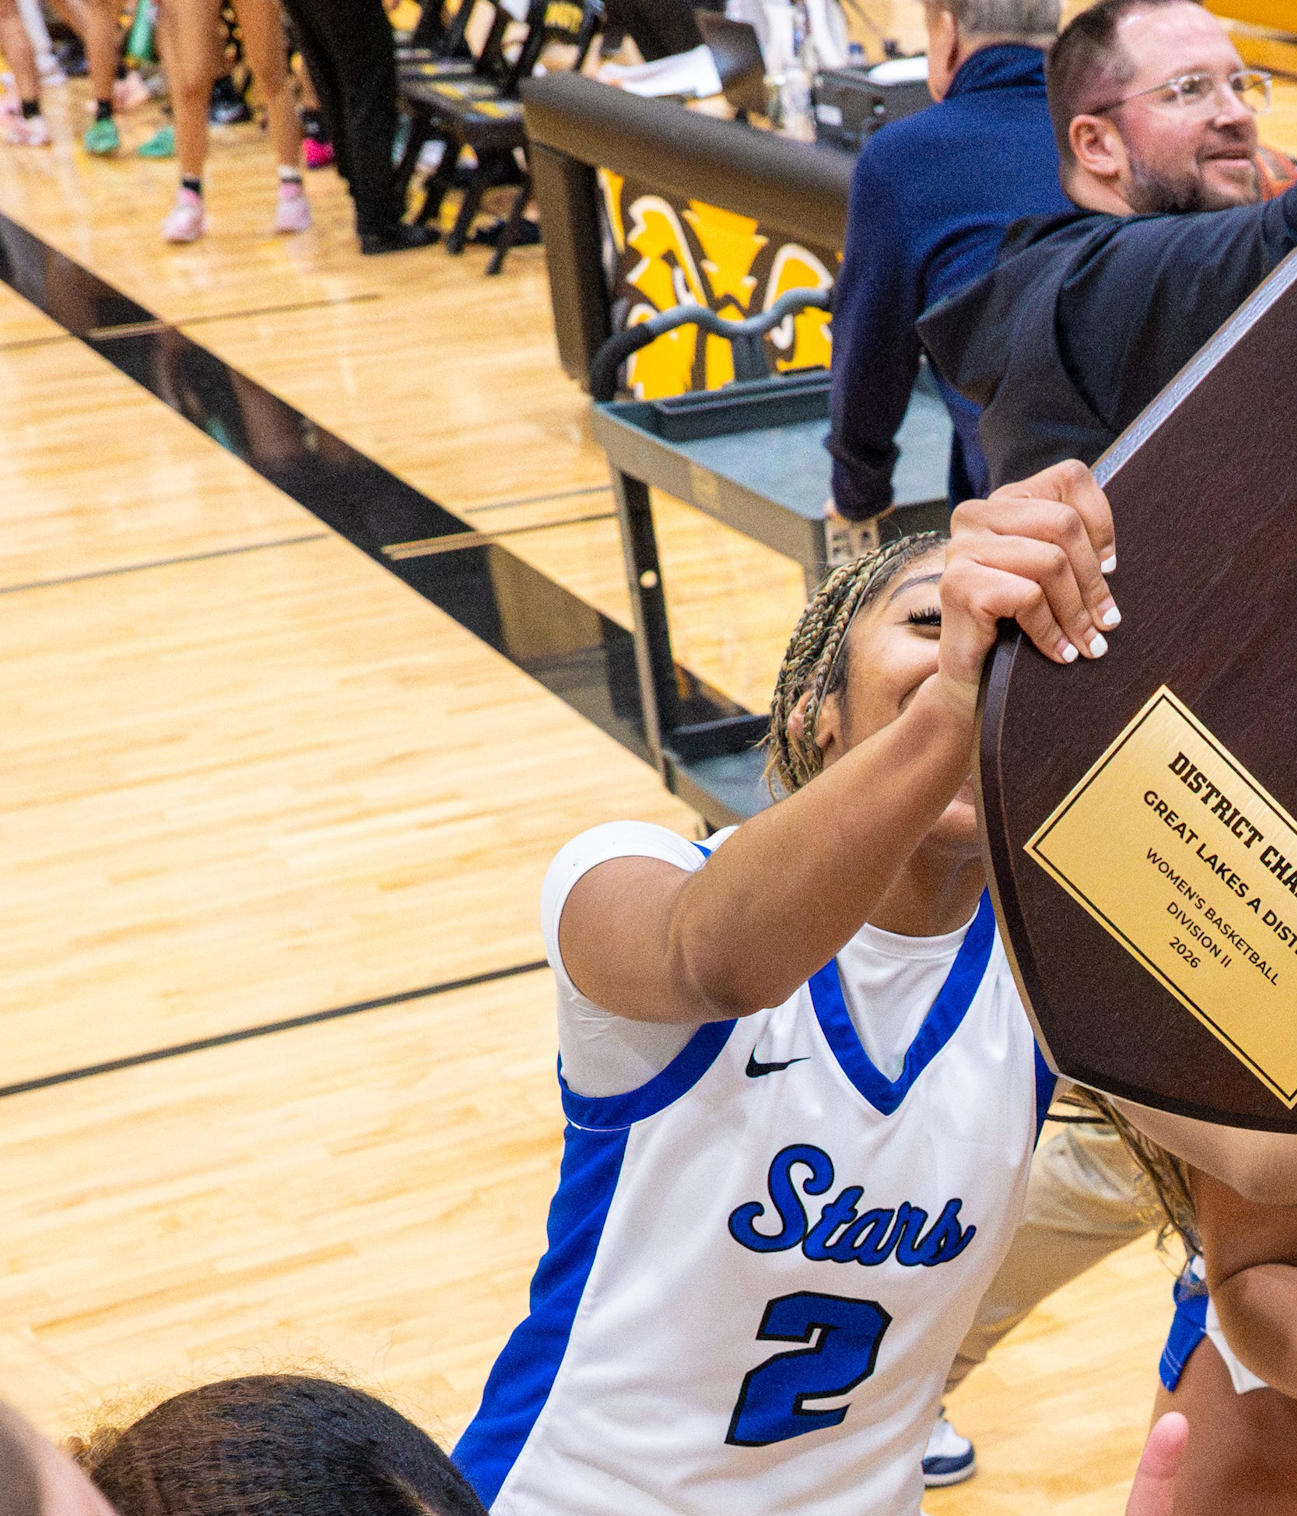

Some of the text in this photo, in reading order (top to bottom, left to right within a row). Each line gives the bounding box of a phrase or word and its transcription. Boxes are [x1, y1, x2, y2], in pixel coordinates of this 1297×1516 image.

[1143, 790, 1199, 845] GREAT
[1195, 843, 1249, 898] LAKES
[1246, 897, 1262, 914] A
[1168, 751, 1264, 849] DISTRICT
[1146, 847, 1280, 986] WOMEN'S BASKETBALL
[1166, 901, 1232, 968] DIVISION II
[1168, 936, 1201, 969] 2026
[728, 1143, 977, 1267] Stars
[724, 1290, 893, 1447] 2
